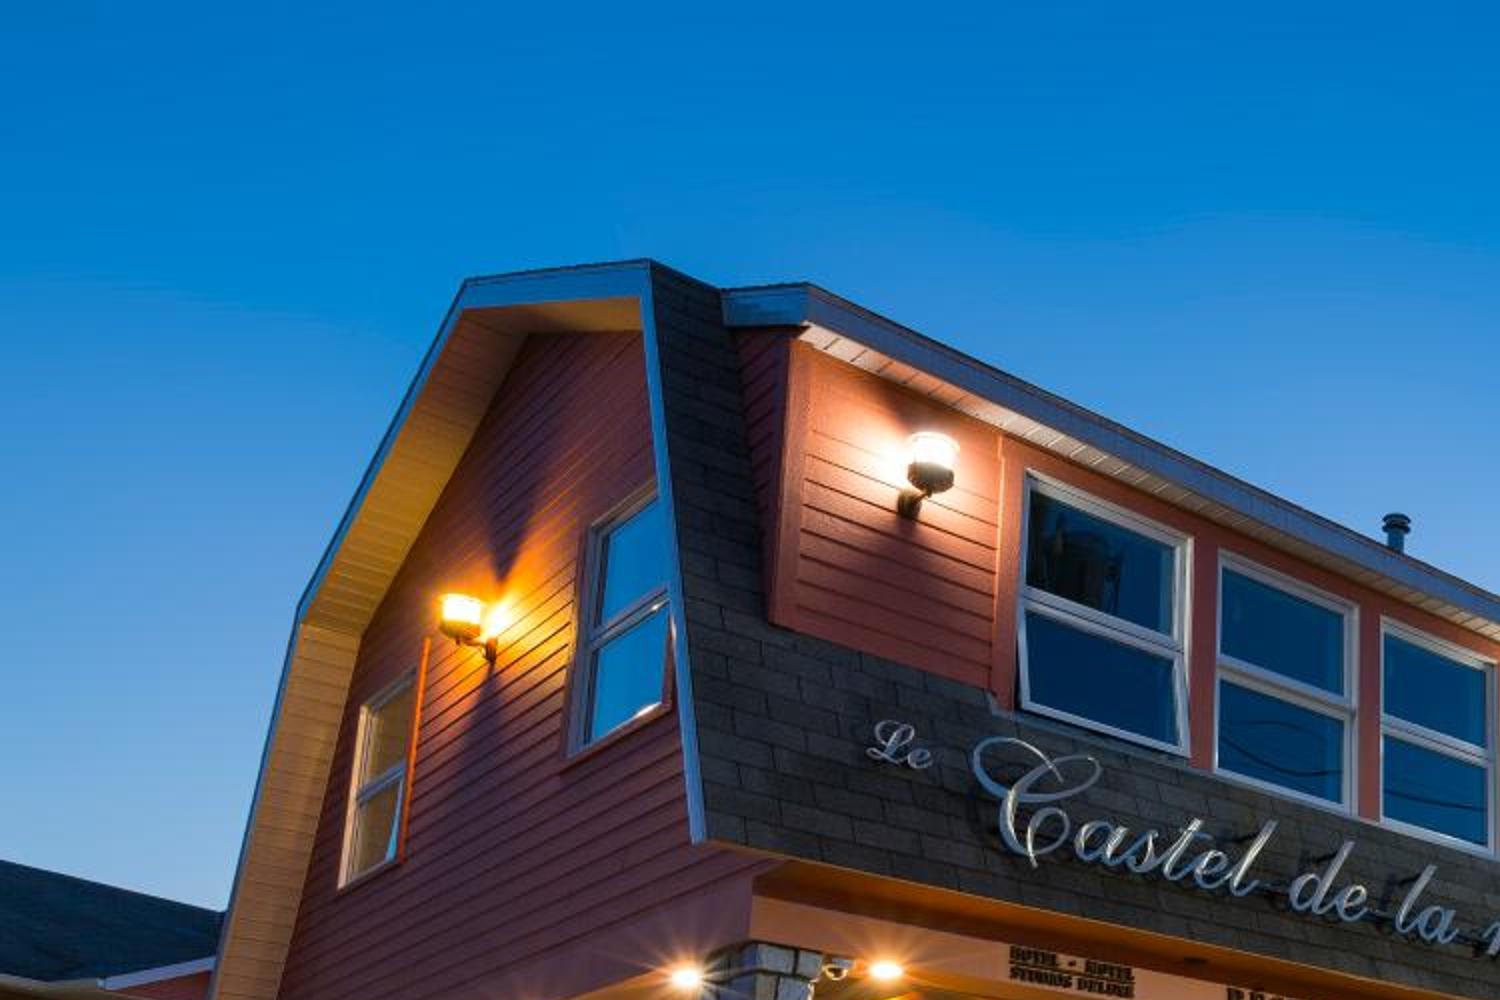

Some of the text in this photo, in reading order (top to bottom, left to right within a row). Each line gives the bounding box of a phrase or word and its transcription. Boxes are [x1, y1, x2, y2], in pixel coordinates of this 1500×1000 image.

[866, 720, 932, 769] Le
[973, 736, 1279, 897] Castel
[1289, 840, 1372, 922] de
[1395, 864, 1460, 944] la
